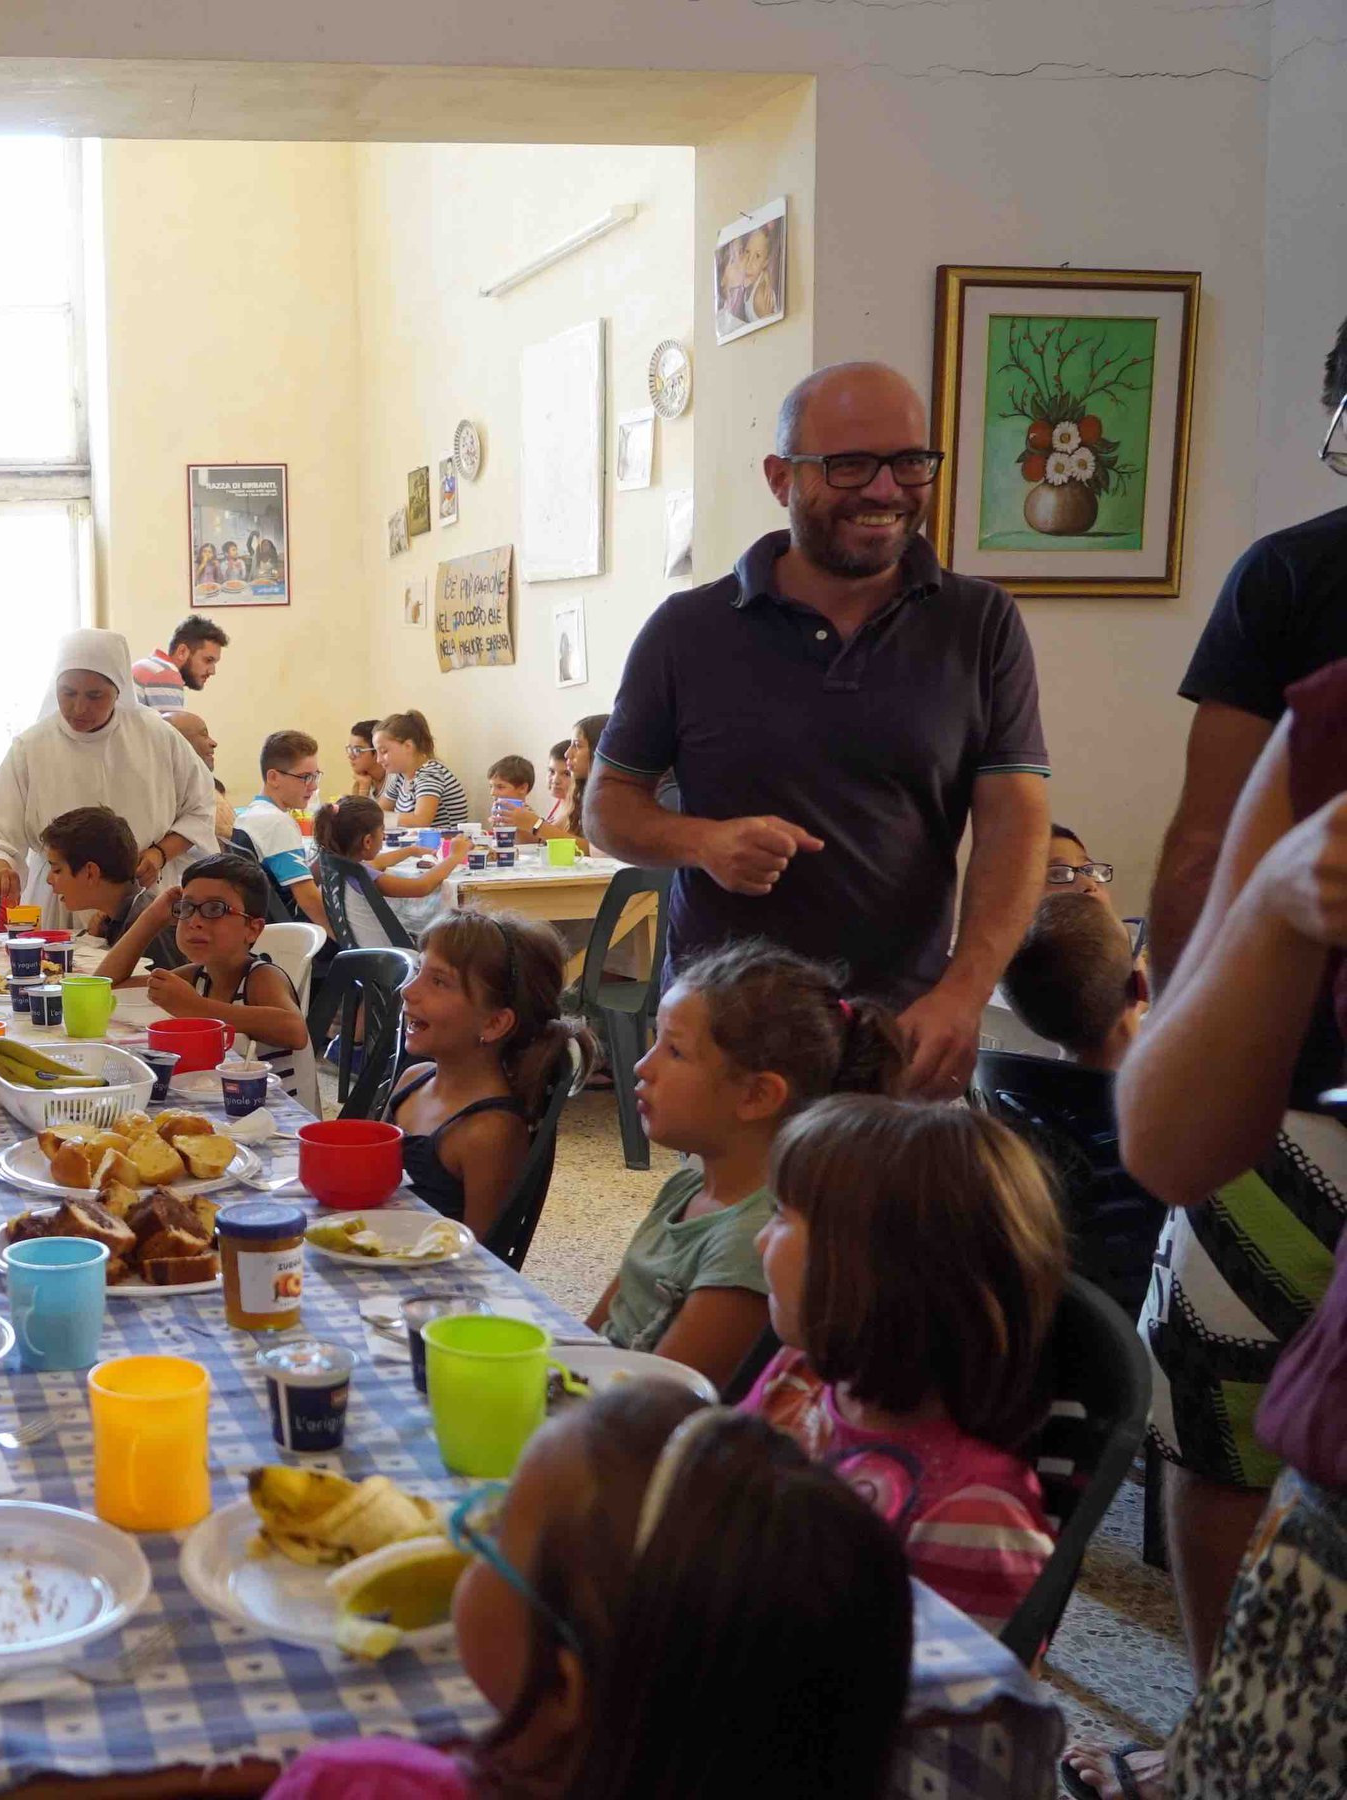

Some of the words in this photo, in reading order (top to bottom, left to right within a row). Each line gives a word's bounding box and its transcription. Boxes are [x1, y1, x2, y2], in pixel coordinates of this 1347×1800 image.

[205, 482, 231, 490] RAZZA
[232, 481, 241, 489] DI
[436, 610, 451, 634] NEL
[17, 961, 39, 970] yogurt
